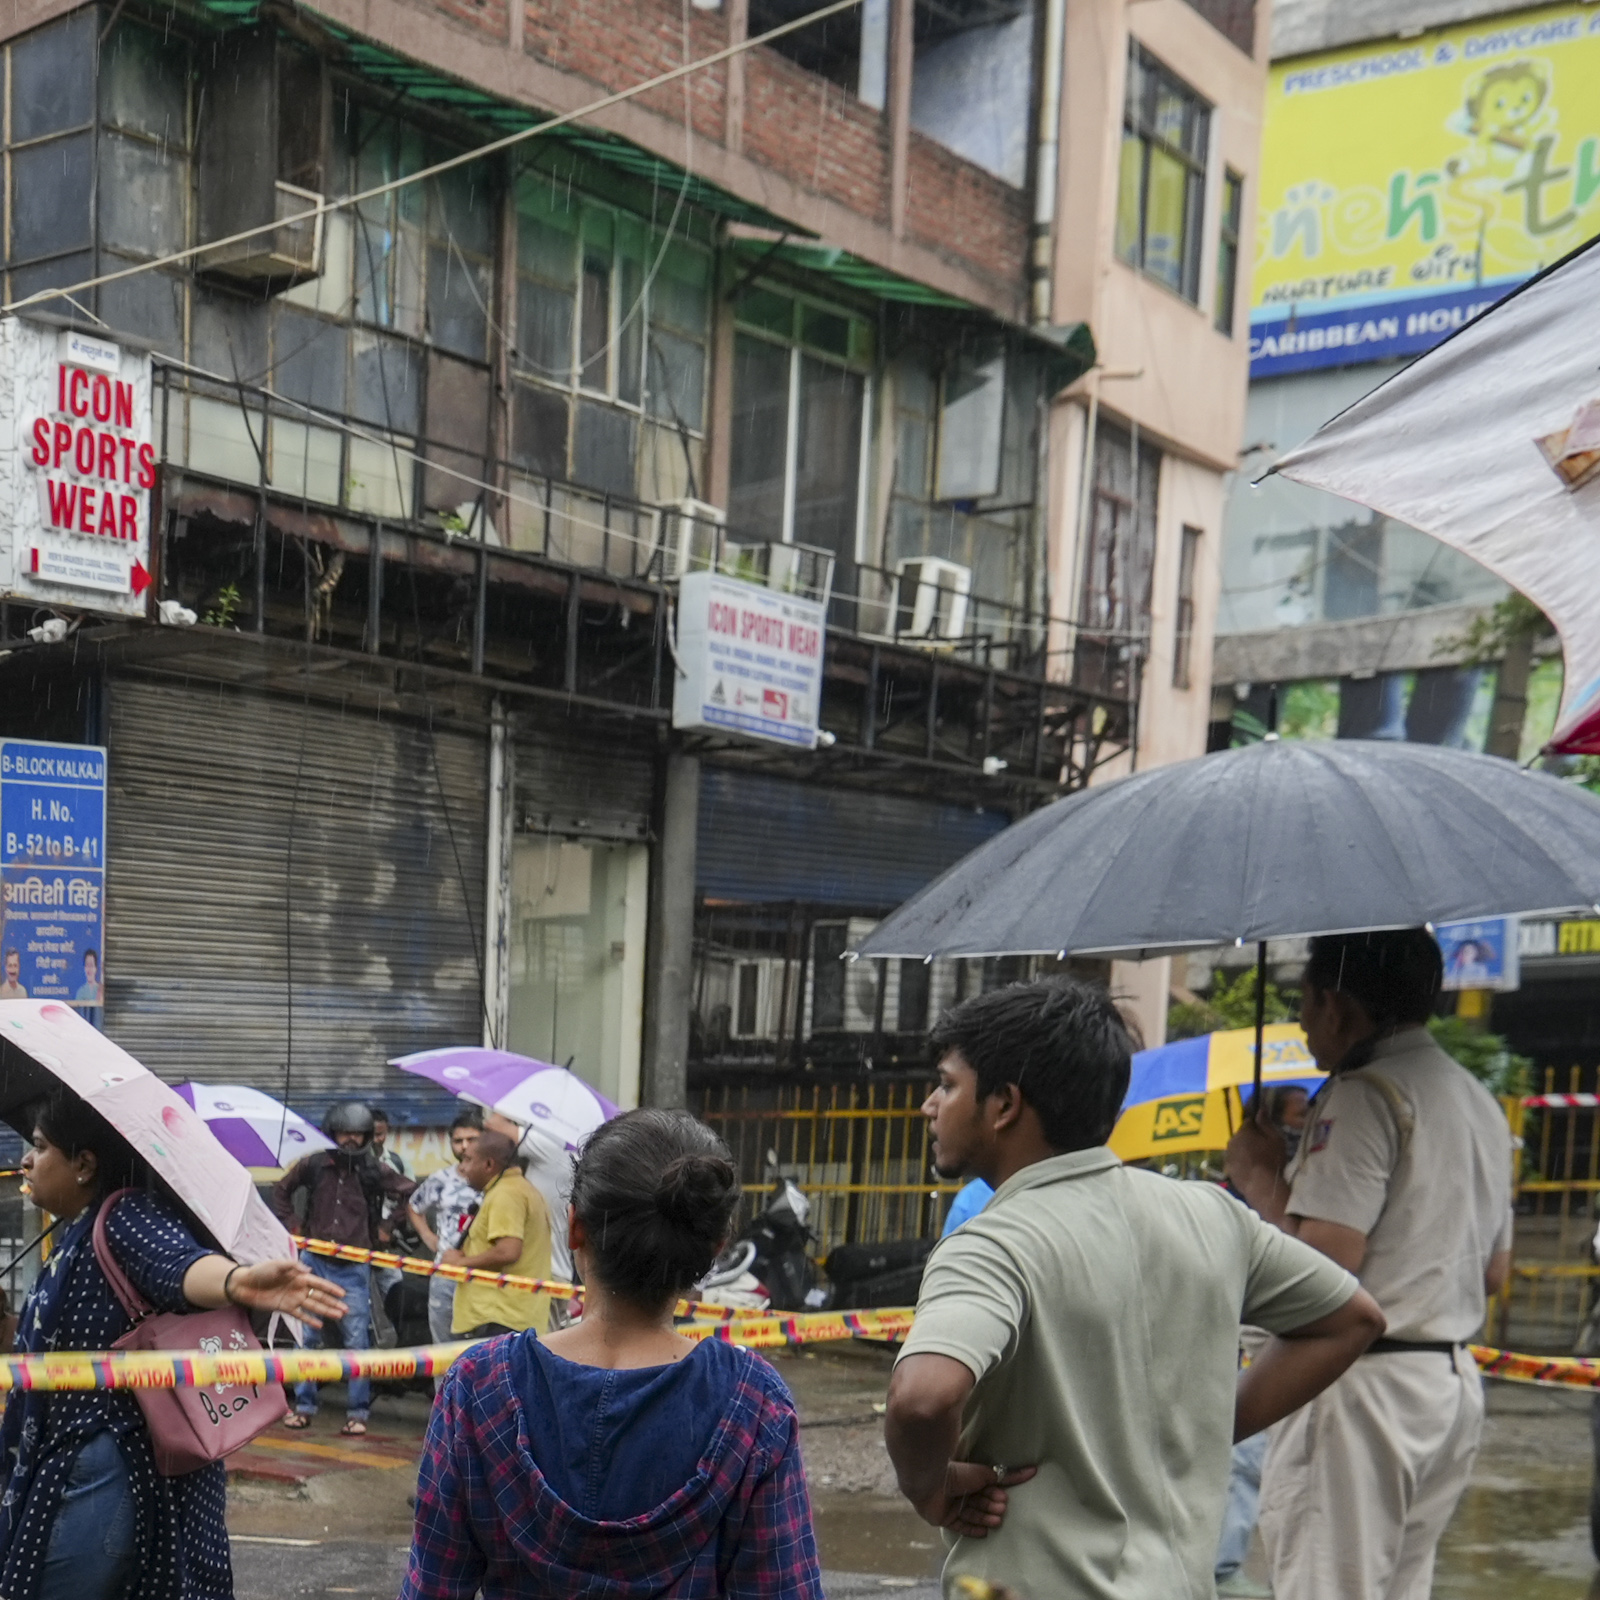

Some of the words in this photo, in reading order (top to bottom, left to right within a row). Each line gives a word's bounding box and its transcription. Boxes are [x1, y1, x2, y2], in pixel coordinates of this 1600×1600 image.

[58, 365, 134, 429] ICON
[32, 417, 156, 489] SPORTS
[47, 479, 140, 542] WEAR
[708, 601, 738, 636] ICON
[742, 610, 784, 649] SPORTS
[56, 759, 103, 780] KALKAJI
[32, 798, 47, 820] H.
[50, 800, 75, 822] No.
[3, 876, 65, 905] आतिशी
[67, 878, 100, 909] सिंह
[117, 1368, 174, 1387] POLICE
[215, 1361, 250, 1376] LINE
[353, 1360, 416, 1377] POLICE
